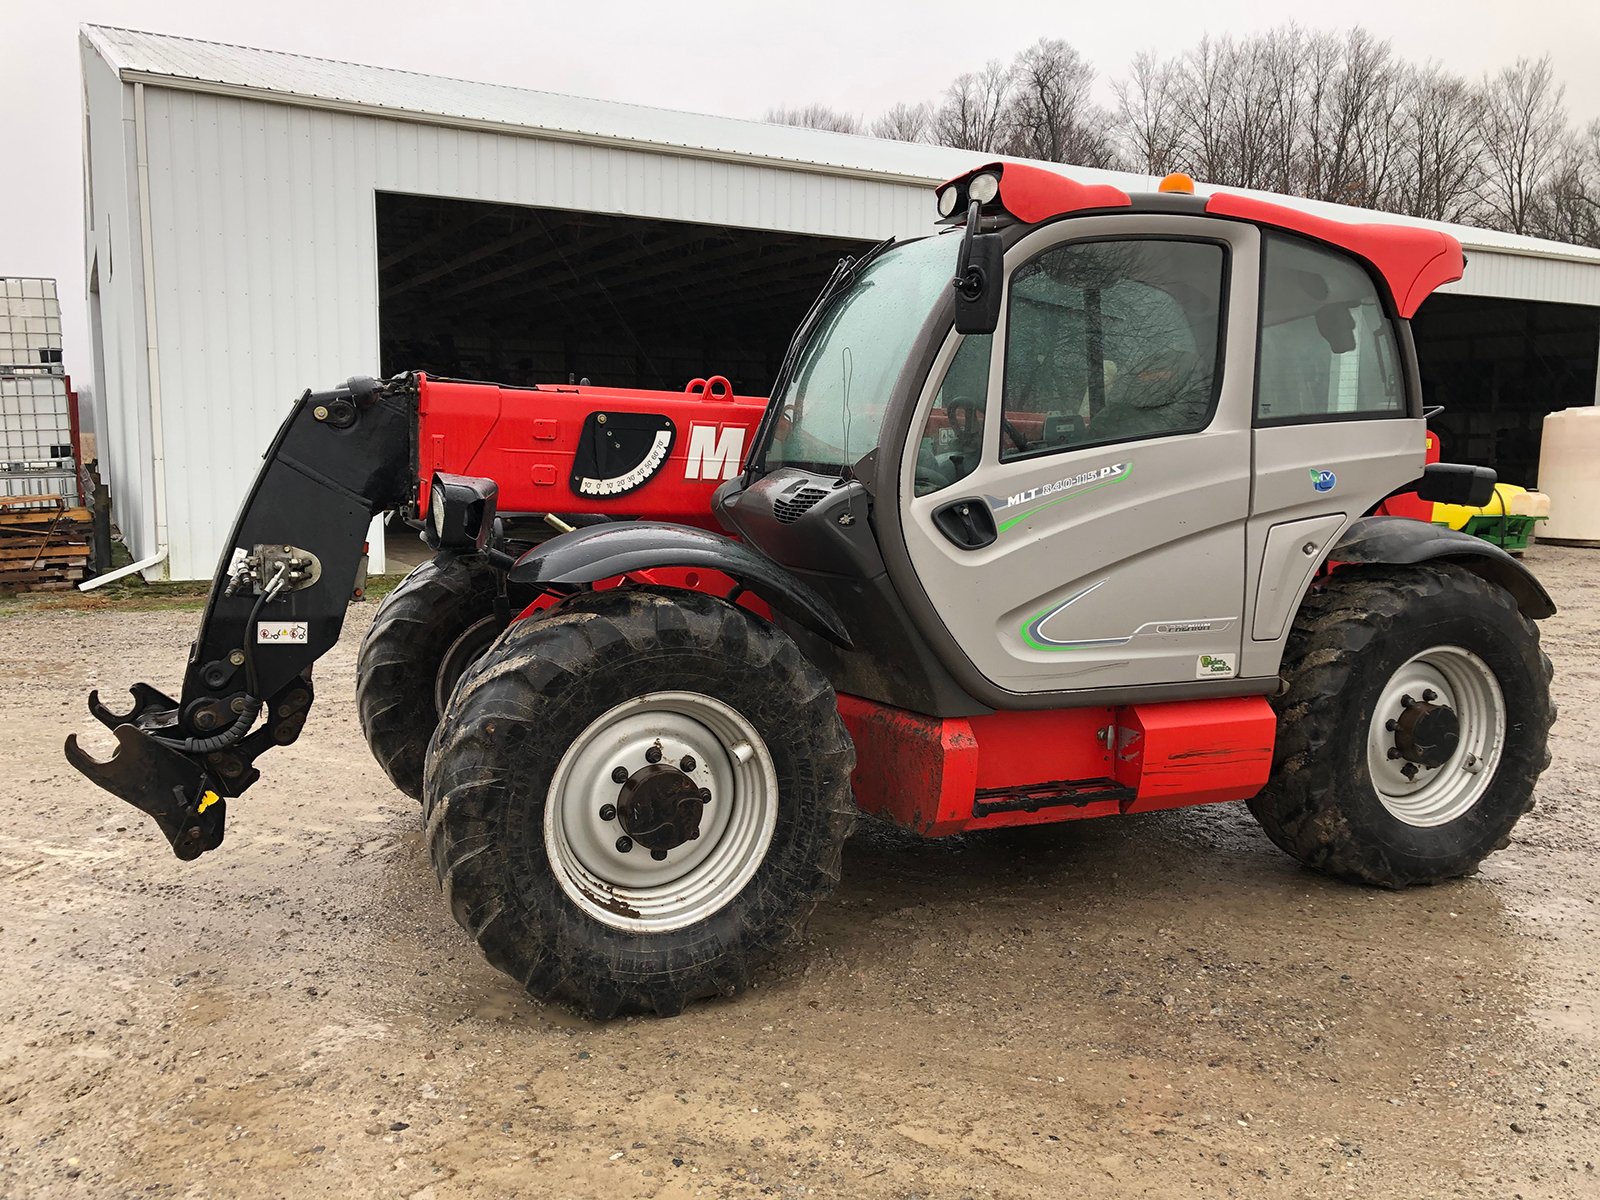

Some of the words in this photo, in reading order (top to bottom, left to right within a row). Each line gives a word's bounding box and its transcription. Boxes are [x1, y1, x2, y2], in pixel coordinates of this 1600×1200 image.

[1007, 487, 1039, 508] MLT
[1042, 470, 1098, 496] 840-115
[1099, 463, 1122, 479] PS
